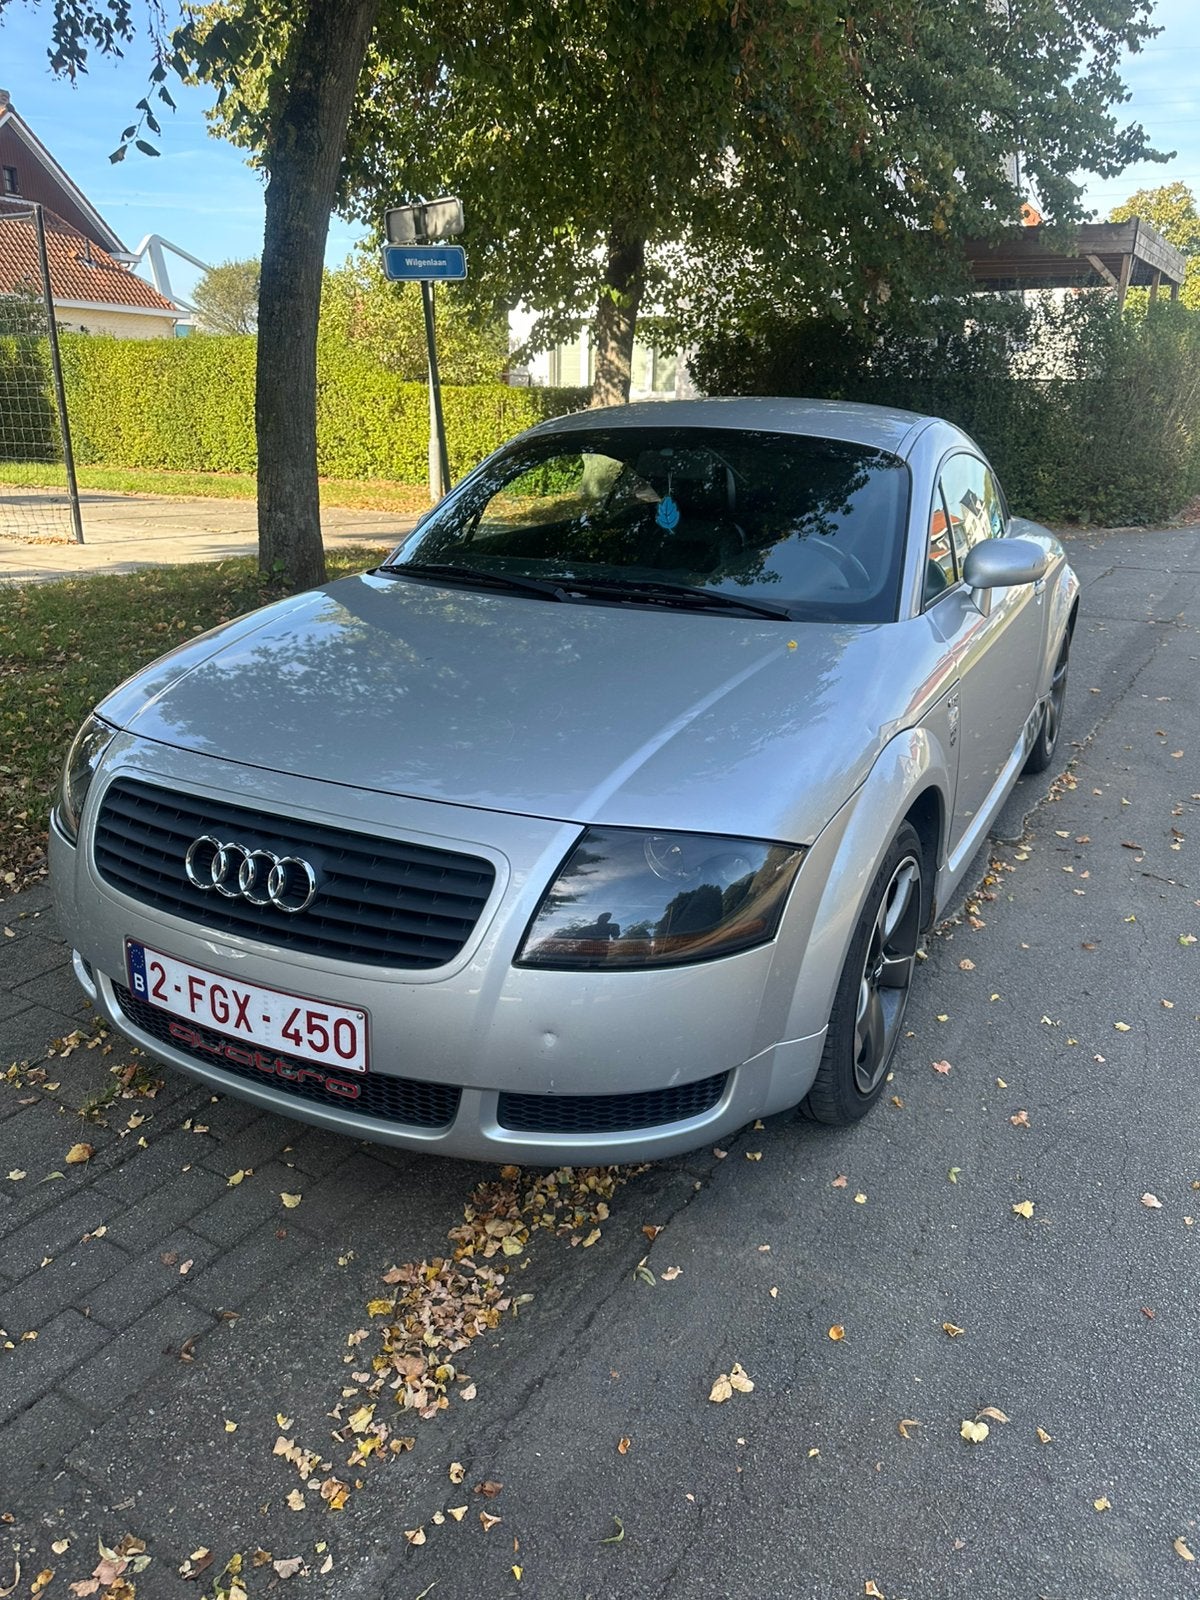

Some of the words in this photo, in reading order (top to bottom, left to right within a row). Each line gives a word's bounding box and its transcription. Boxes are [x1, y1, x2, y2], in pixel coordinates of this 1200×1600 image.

[405, 258, 447, 267] Wilgenlaan
[133, 972, 145, 992] B
[150, 961, 357, 1060] 2-FGX-450
[169, 1022, 361, 1099] quattro
